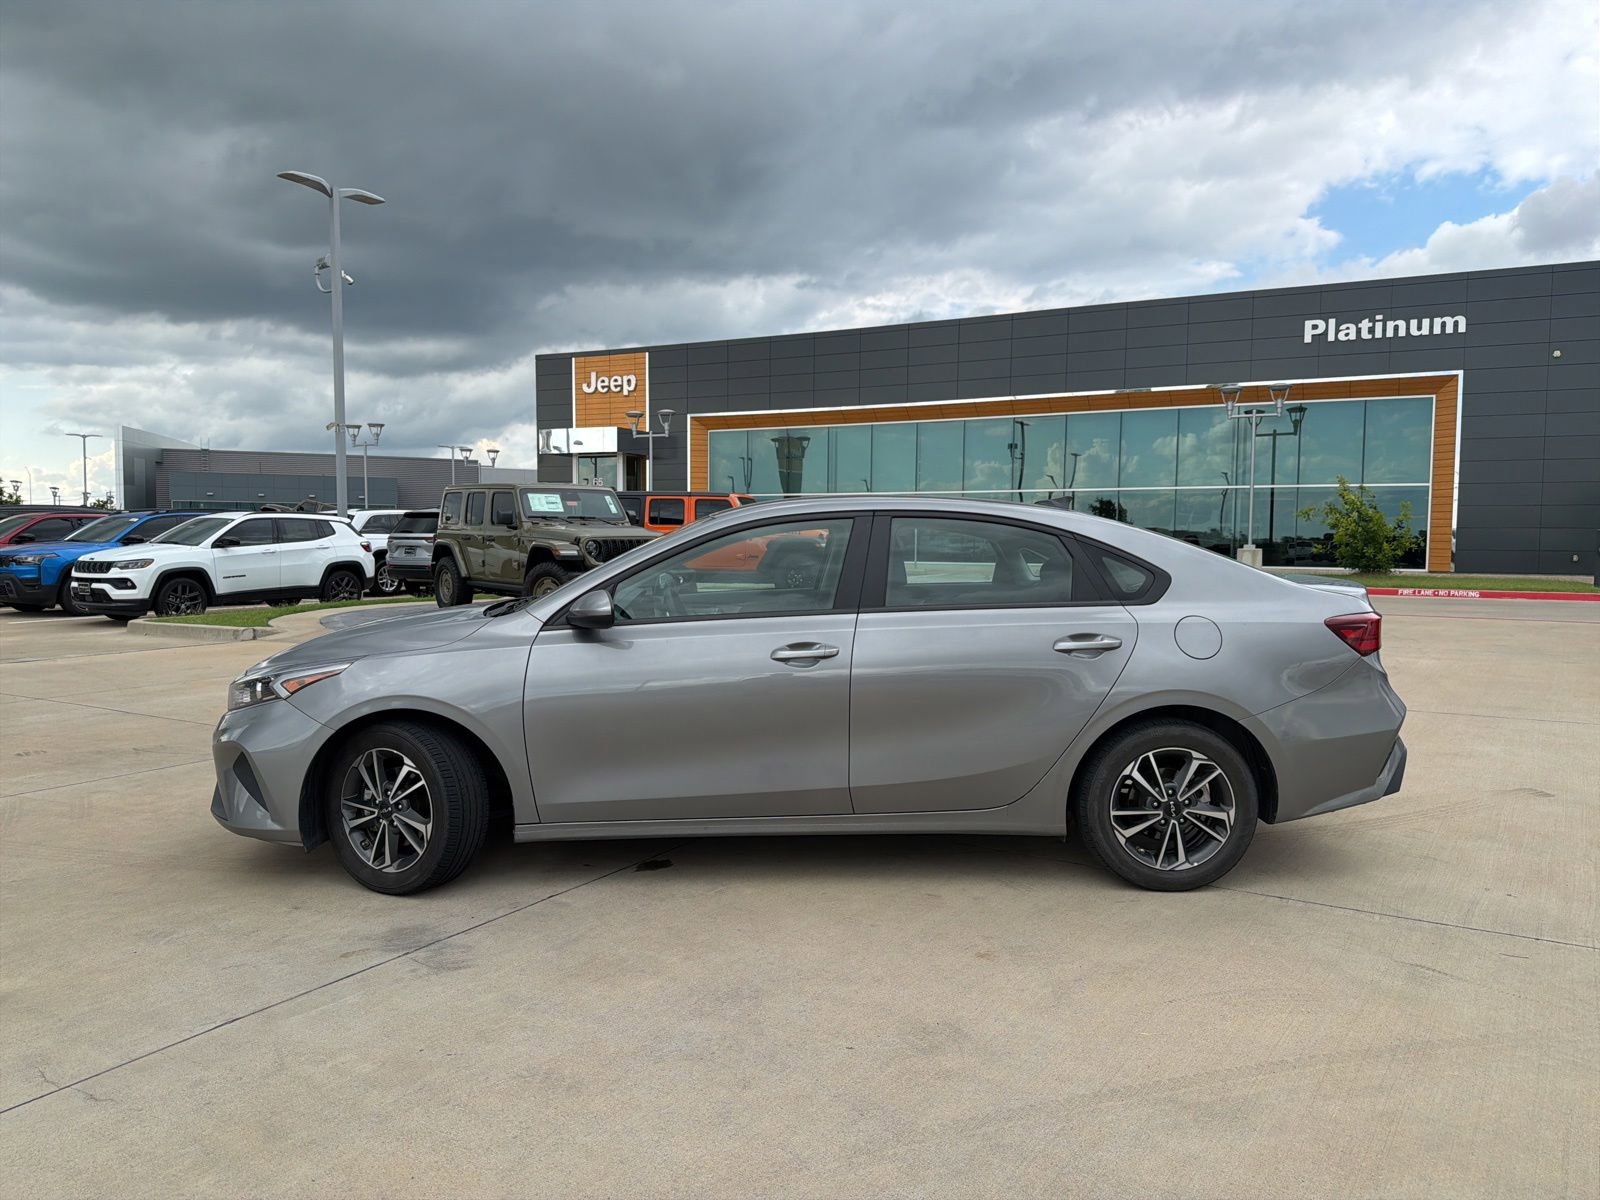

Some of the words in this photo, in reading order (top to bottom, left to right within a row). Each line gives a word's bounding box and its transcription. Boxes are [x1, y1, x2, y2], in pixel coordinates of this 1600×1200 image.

[1303, 314, 1467, 344] Platinum
[582, 371, 637, 396] Jeep
[1415, 589, 1435, 597] LANE
[1439, 590, 1449, 598] NO
[1450, 590, 1480, 598] PARKING
